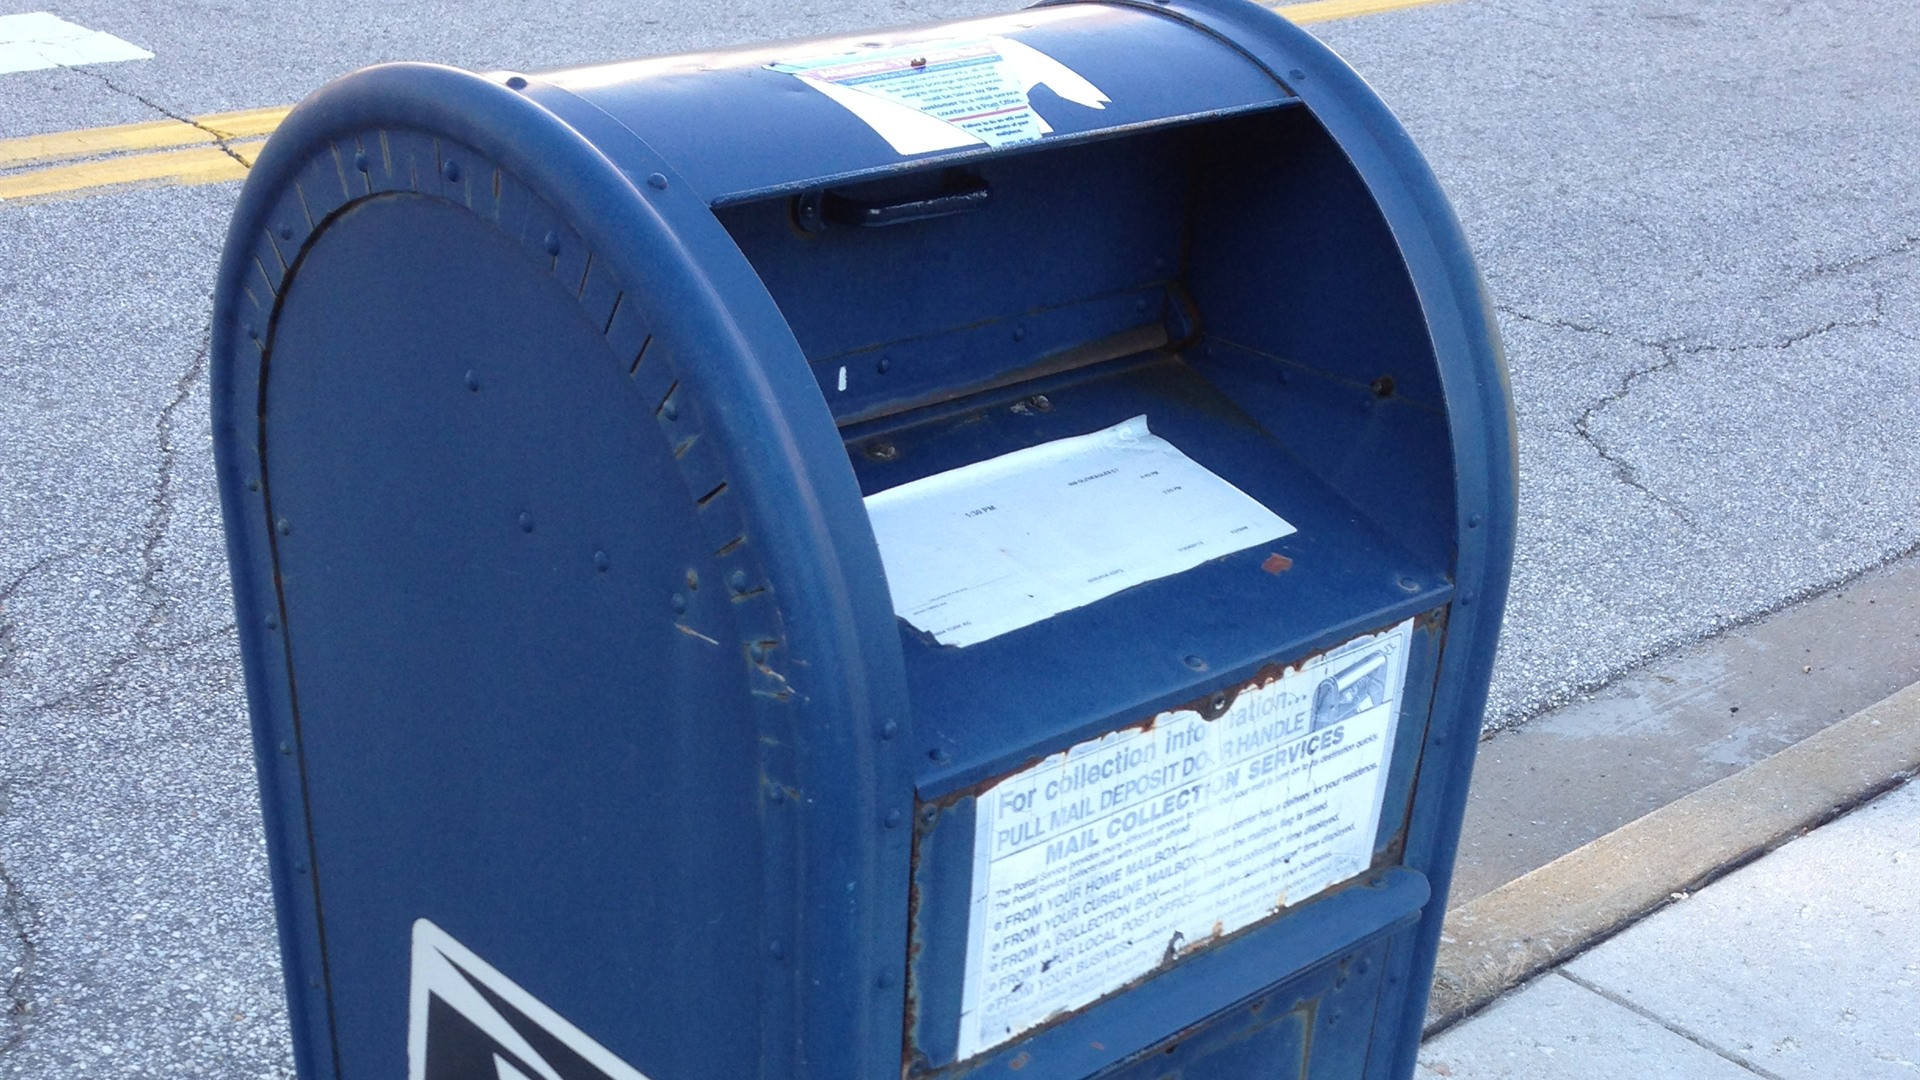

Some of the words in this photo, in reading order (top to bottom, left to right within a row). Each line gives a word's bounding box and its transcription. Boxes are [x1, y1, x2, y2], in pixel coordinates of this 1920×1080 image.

[981, 504, 998, 515] PM
[996, 813, 1046, 852] PULL
[1049, 793, 1096, 831] MAIL
[1099, 760, 1180, 811] DEPOSIT
[1181, 738, 1234, 777] DOR
[1236, 710, 1306, 755] HANDLE
[998, 780, 1037, 820] For
[1043, 734, 1157, 803] collection
[1164, 676, 1310, 755] infoation...
[1044, 824, 1099, 865] MAIL
[1246, 723, 1346, 781] SERVICES
[995, 885, 1011, 899] The
[1013, 874, 1036, 892] Postal
[1039, 862, 1066, 881] Service
[995, 898, 1009, 912] The
[1012, 887, 1036, 905] Postal
[1039, 875, 1066, 894] Service
[1002, 921, 1040, 950] FROM
[1043, 905, 1079, 932] YOUR
[1082, 877, 1142, 915] CURBLINE
[1003, 901, 1042, 929] FROM
[1045, 884, 1081, 911] YOUR
[1084, 867, 1122, 895] HOME
[999, 962, 1035, 989] FROM
[1039, 945, 1074, 971] UR
[1078, 926, 1118, 954] LOCAL
[1120, 910, 1152, 935] POST
[1000, 942, 1038, 970] FROM
[1043, 937, 1050, 951] A
[1056, 901, 1130, 946] COLLECTION
[996, 982, 1034, 1010] FROM
[1038, 964, 1072, 991] YOUR
